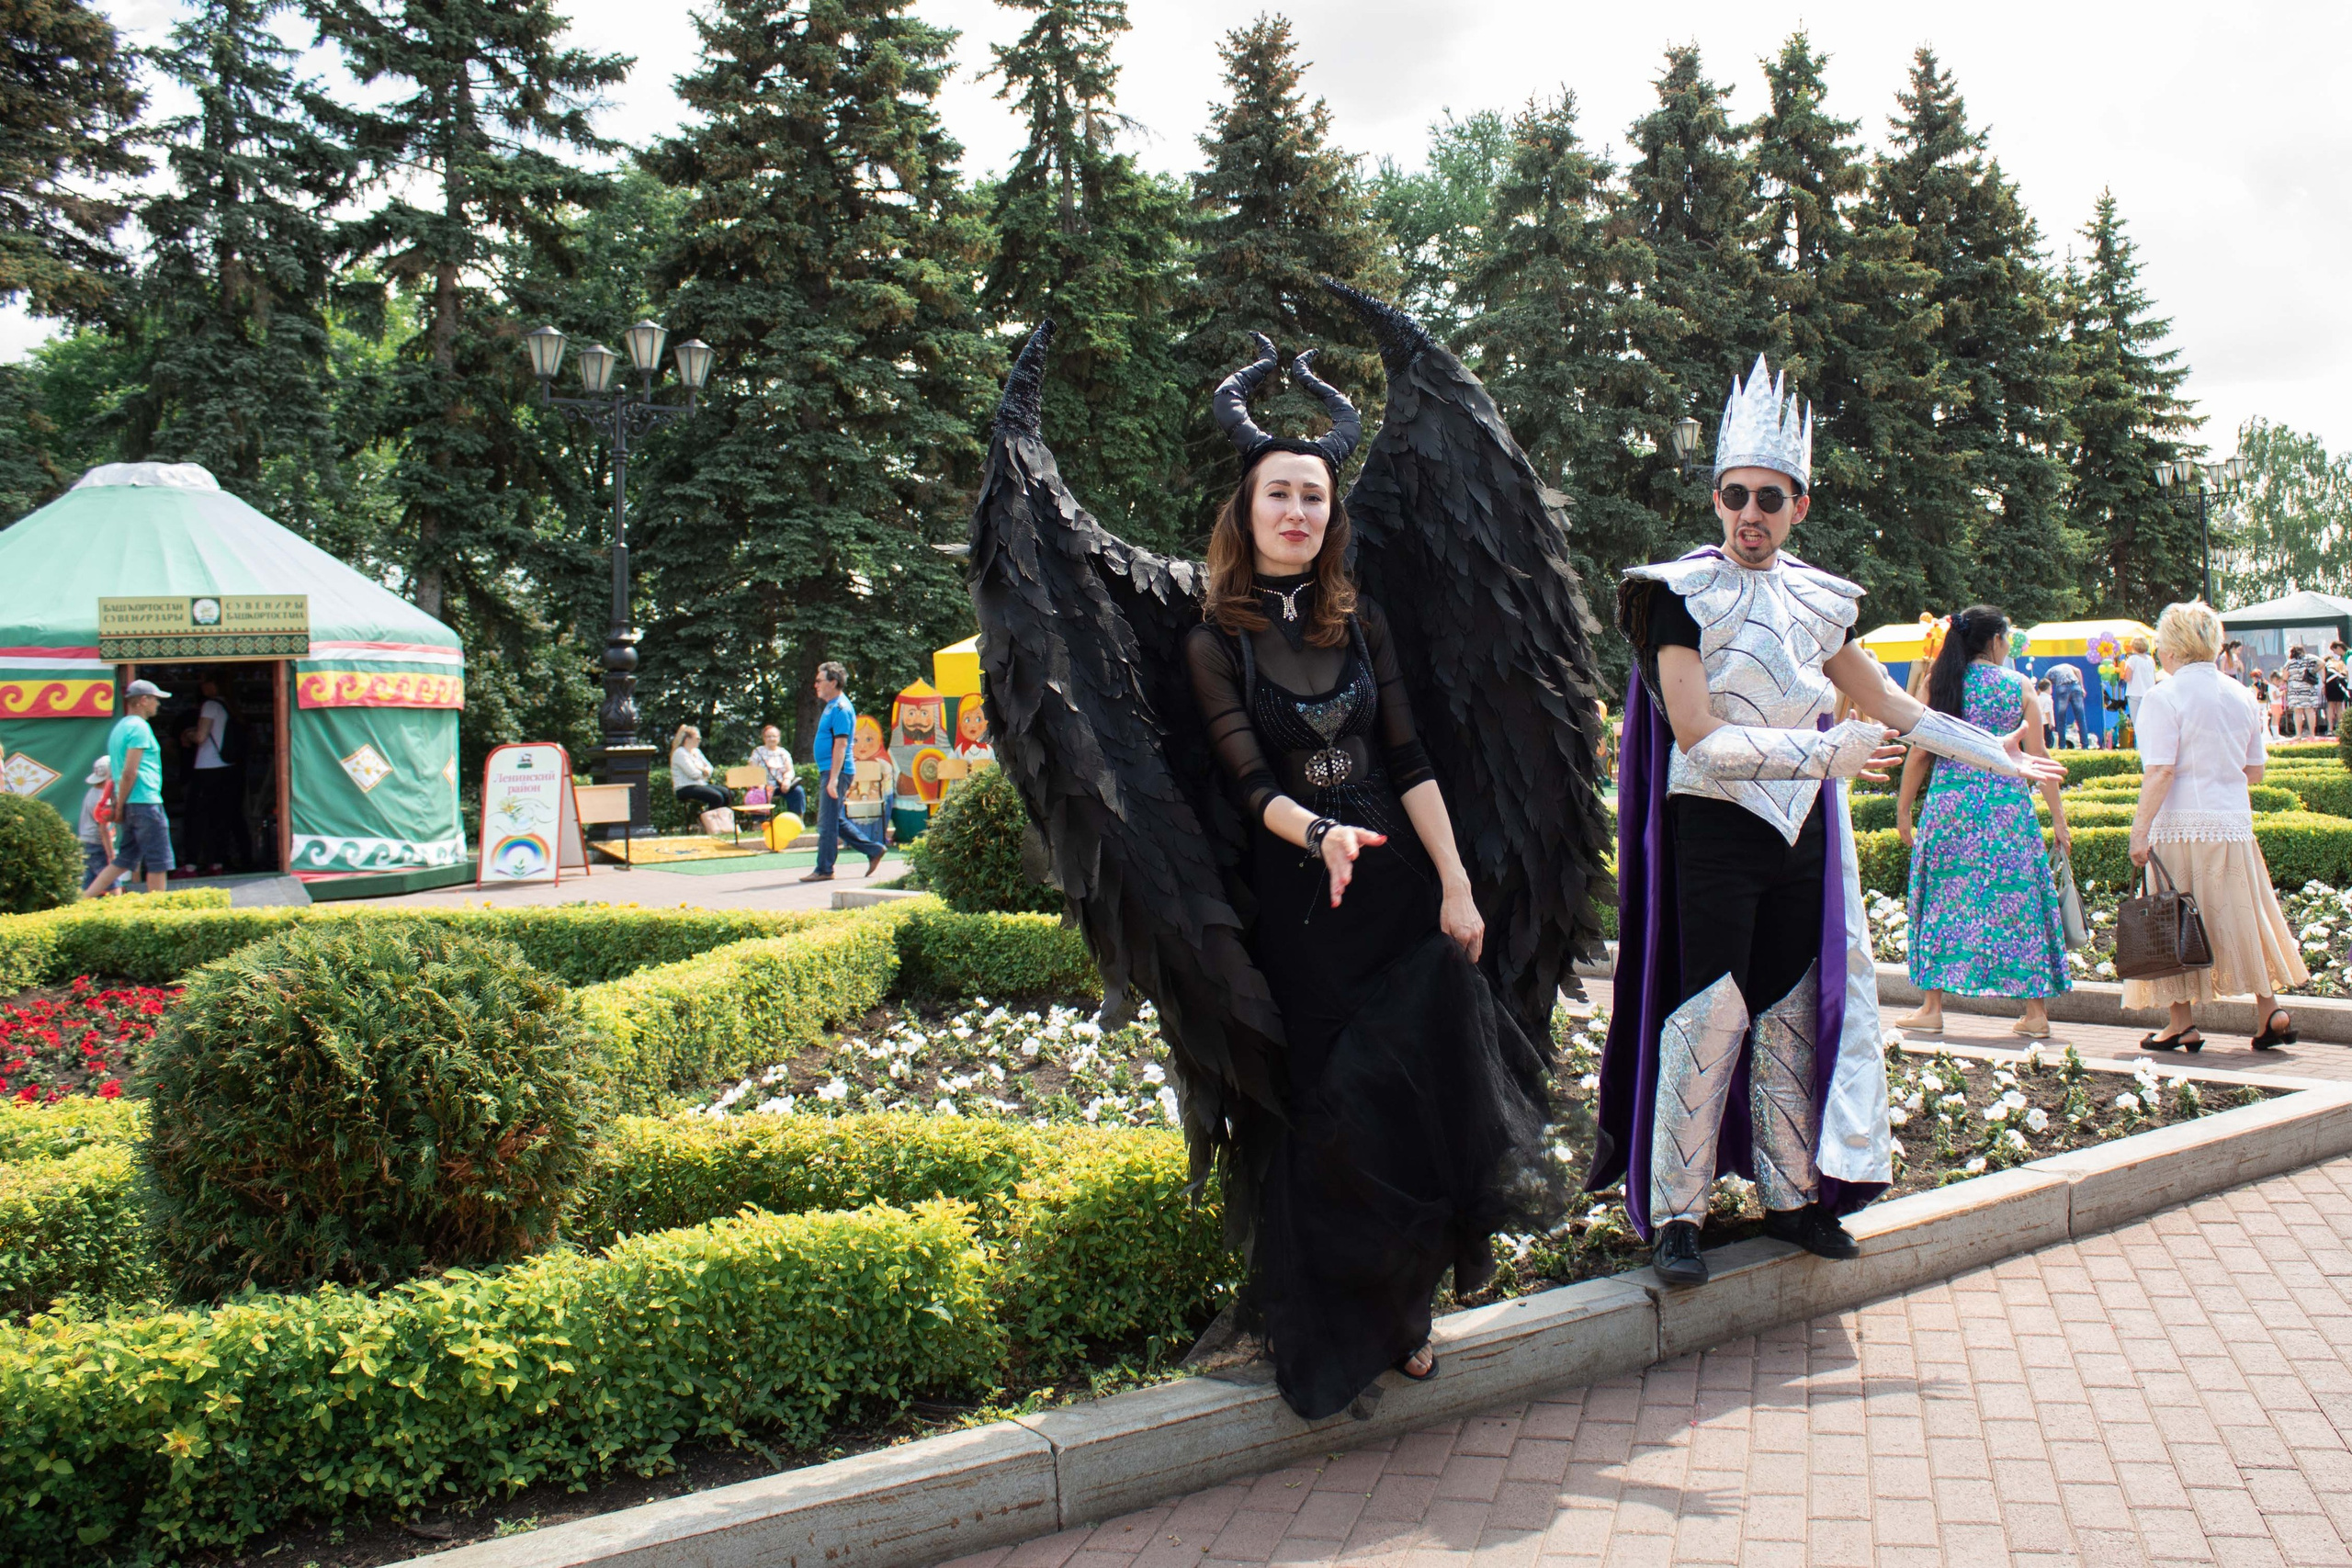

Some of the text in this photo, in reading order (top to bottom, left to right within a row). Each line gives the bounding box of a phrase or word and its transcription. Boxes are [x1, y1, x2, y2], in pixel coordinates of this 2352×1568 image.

[225, 602, 303, 610] СУВЕНИРЫ
[226, 611, 304, 620] БАШКОРТОСТАНА
[493, 771, 556, 783] Ленинский
[507, 783, 541, 795] район
